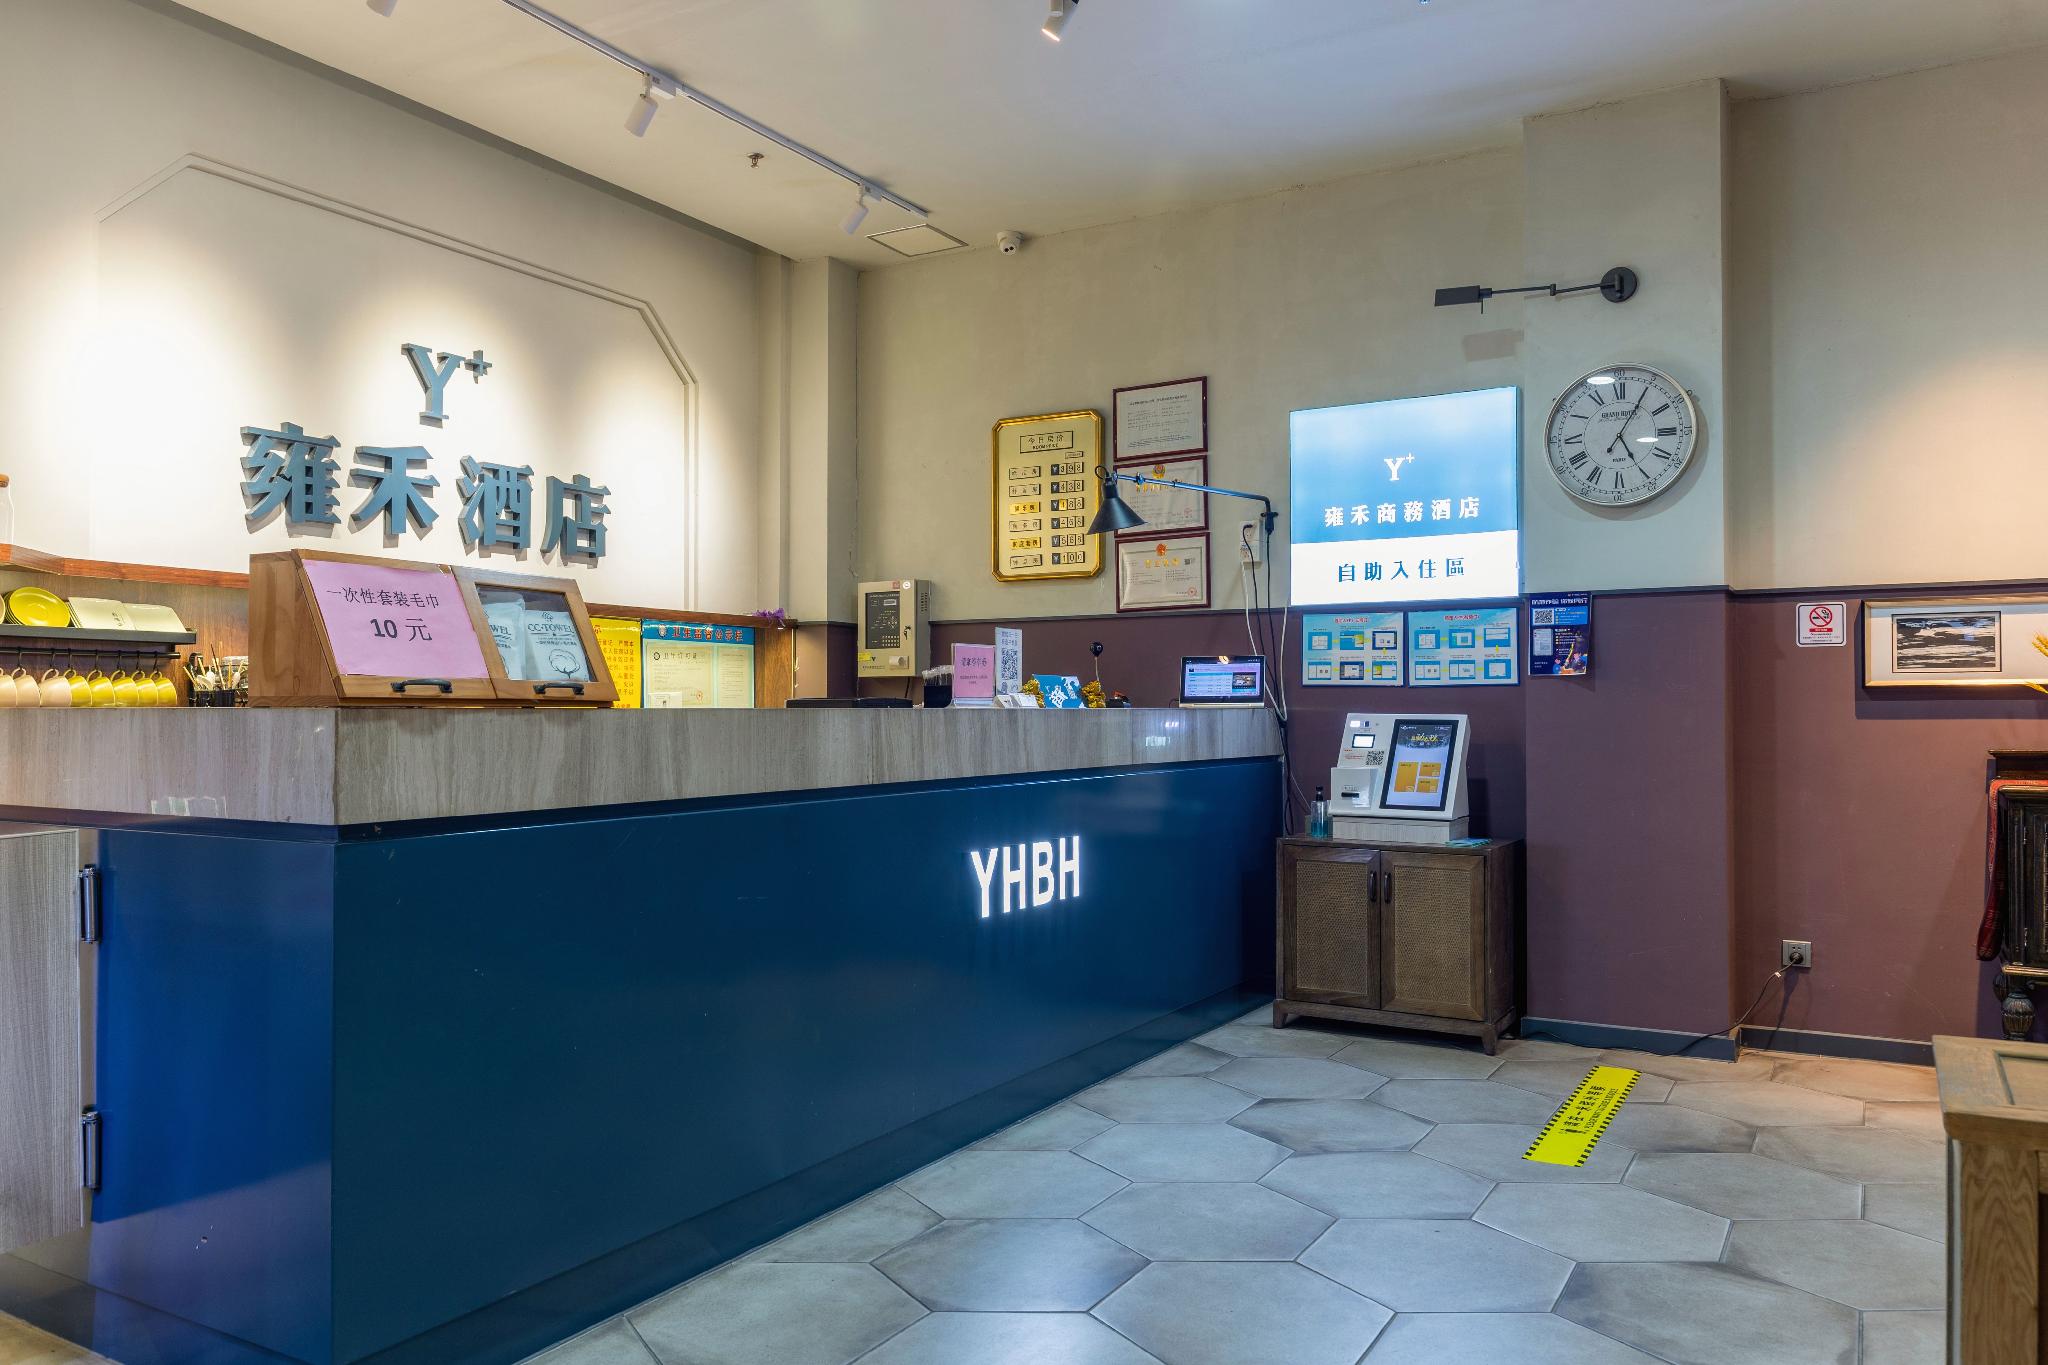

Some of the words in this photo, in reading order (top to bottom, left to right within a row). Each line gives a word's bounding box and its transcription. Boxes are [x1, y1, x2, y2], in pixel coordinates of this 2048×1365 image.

[1613, 369, 1625, 377] 60
[1673, 393, 1684, 404] 10
[1683, 425, 1693, 435] 15
[240, 421, 612, 557] 雍禾酒店
[1324, 496, 1480, 528] 雍禾商務酒店
[1338, 557, 1465, 583] 自助入住區
[326, 586, 440, 609] 一次性套装毛巾
[370, 618, 398, 639] 10
[405, 618, 432, 641] 元
[970, 836, 1080, 918] YHBH
